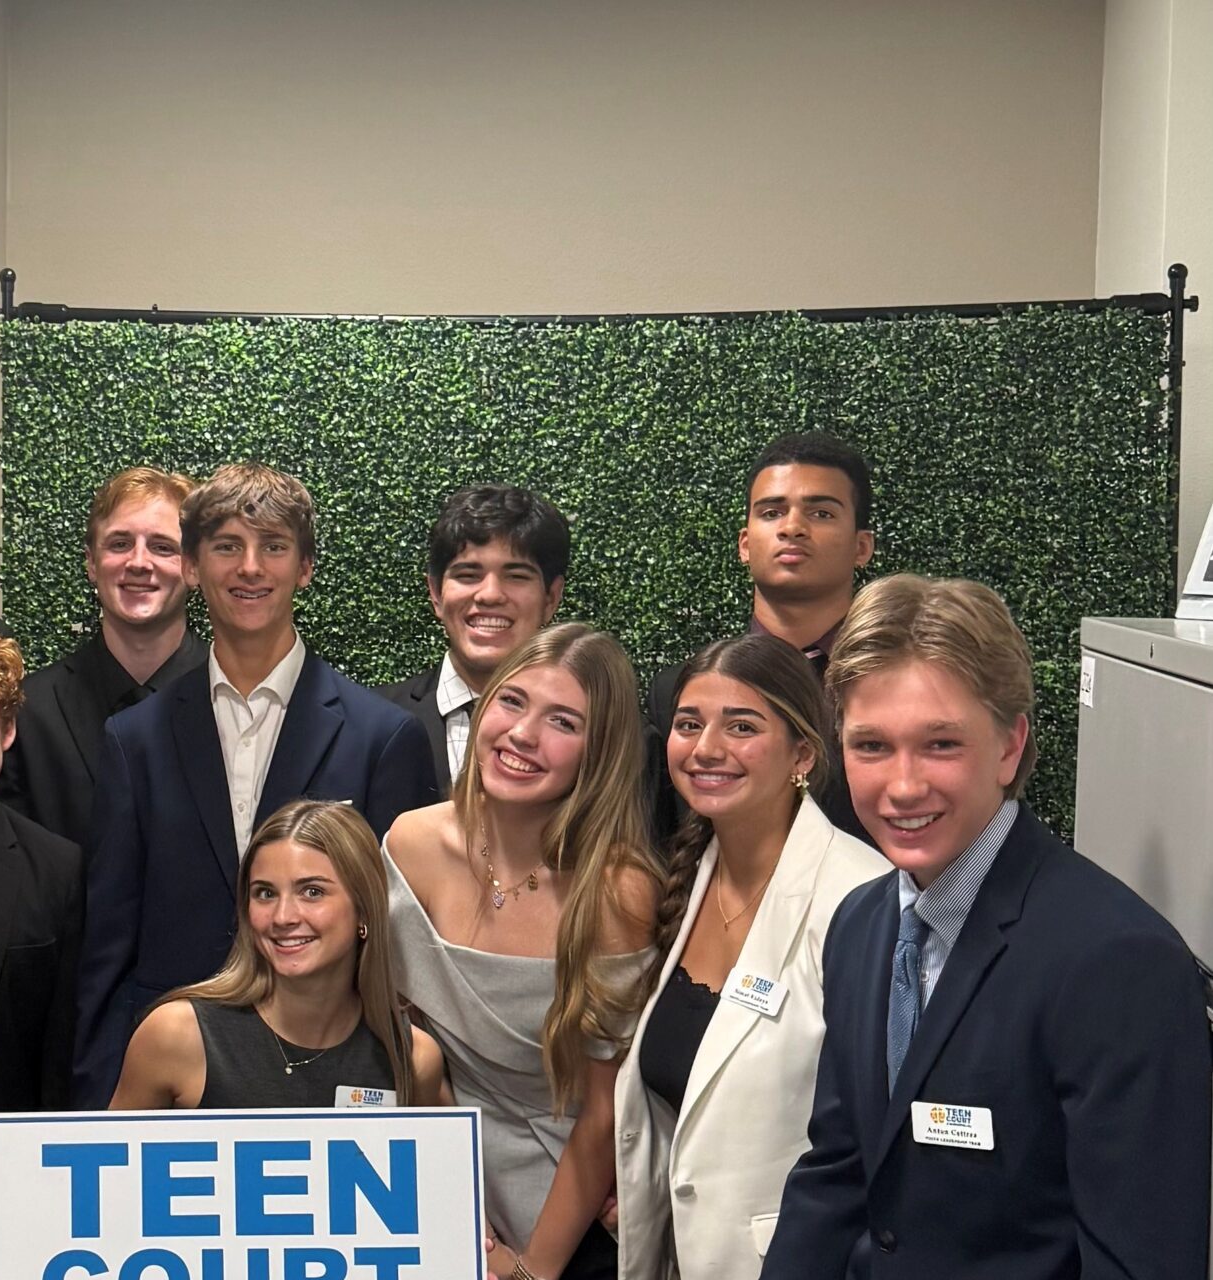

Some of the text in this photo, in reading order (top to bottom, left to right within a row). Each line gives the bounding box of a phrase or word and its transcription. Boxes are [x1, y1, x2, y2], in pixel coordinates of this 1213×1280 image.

[945, 1107, 972, 1118] TEEN
[946, 1115, 972, 1125] COURT
[41, 1139, 419, 1238] TEEN
